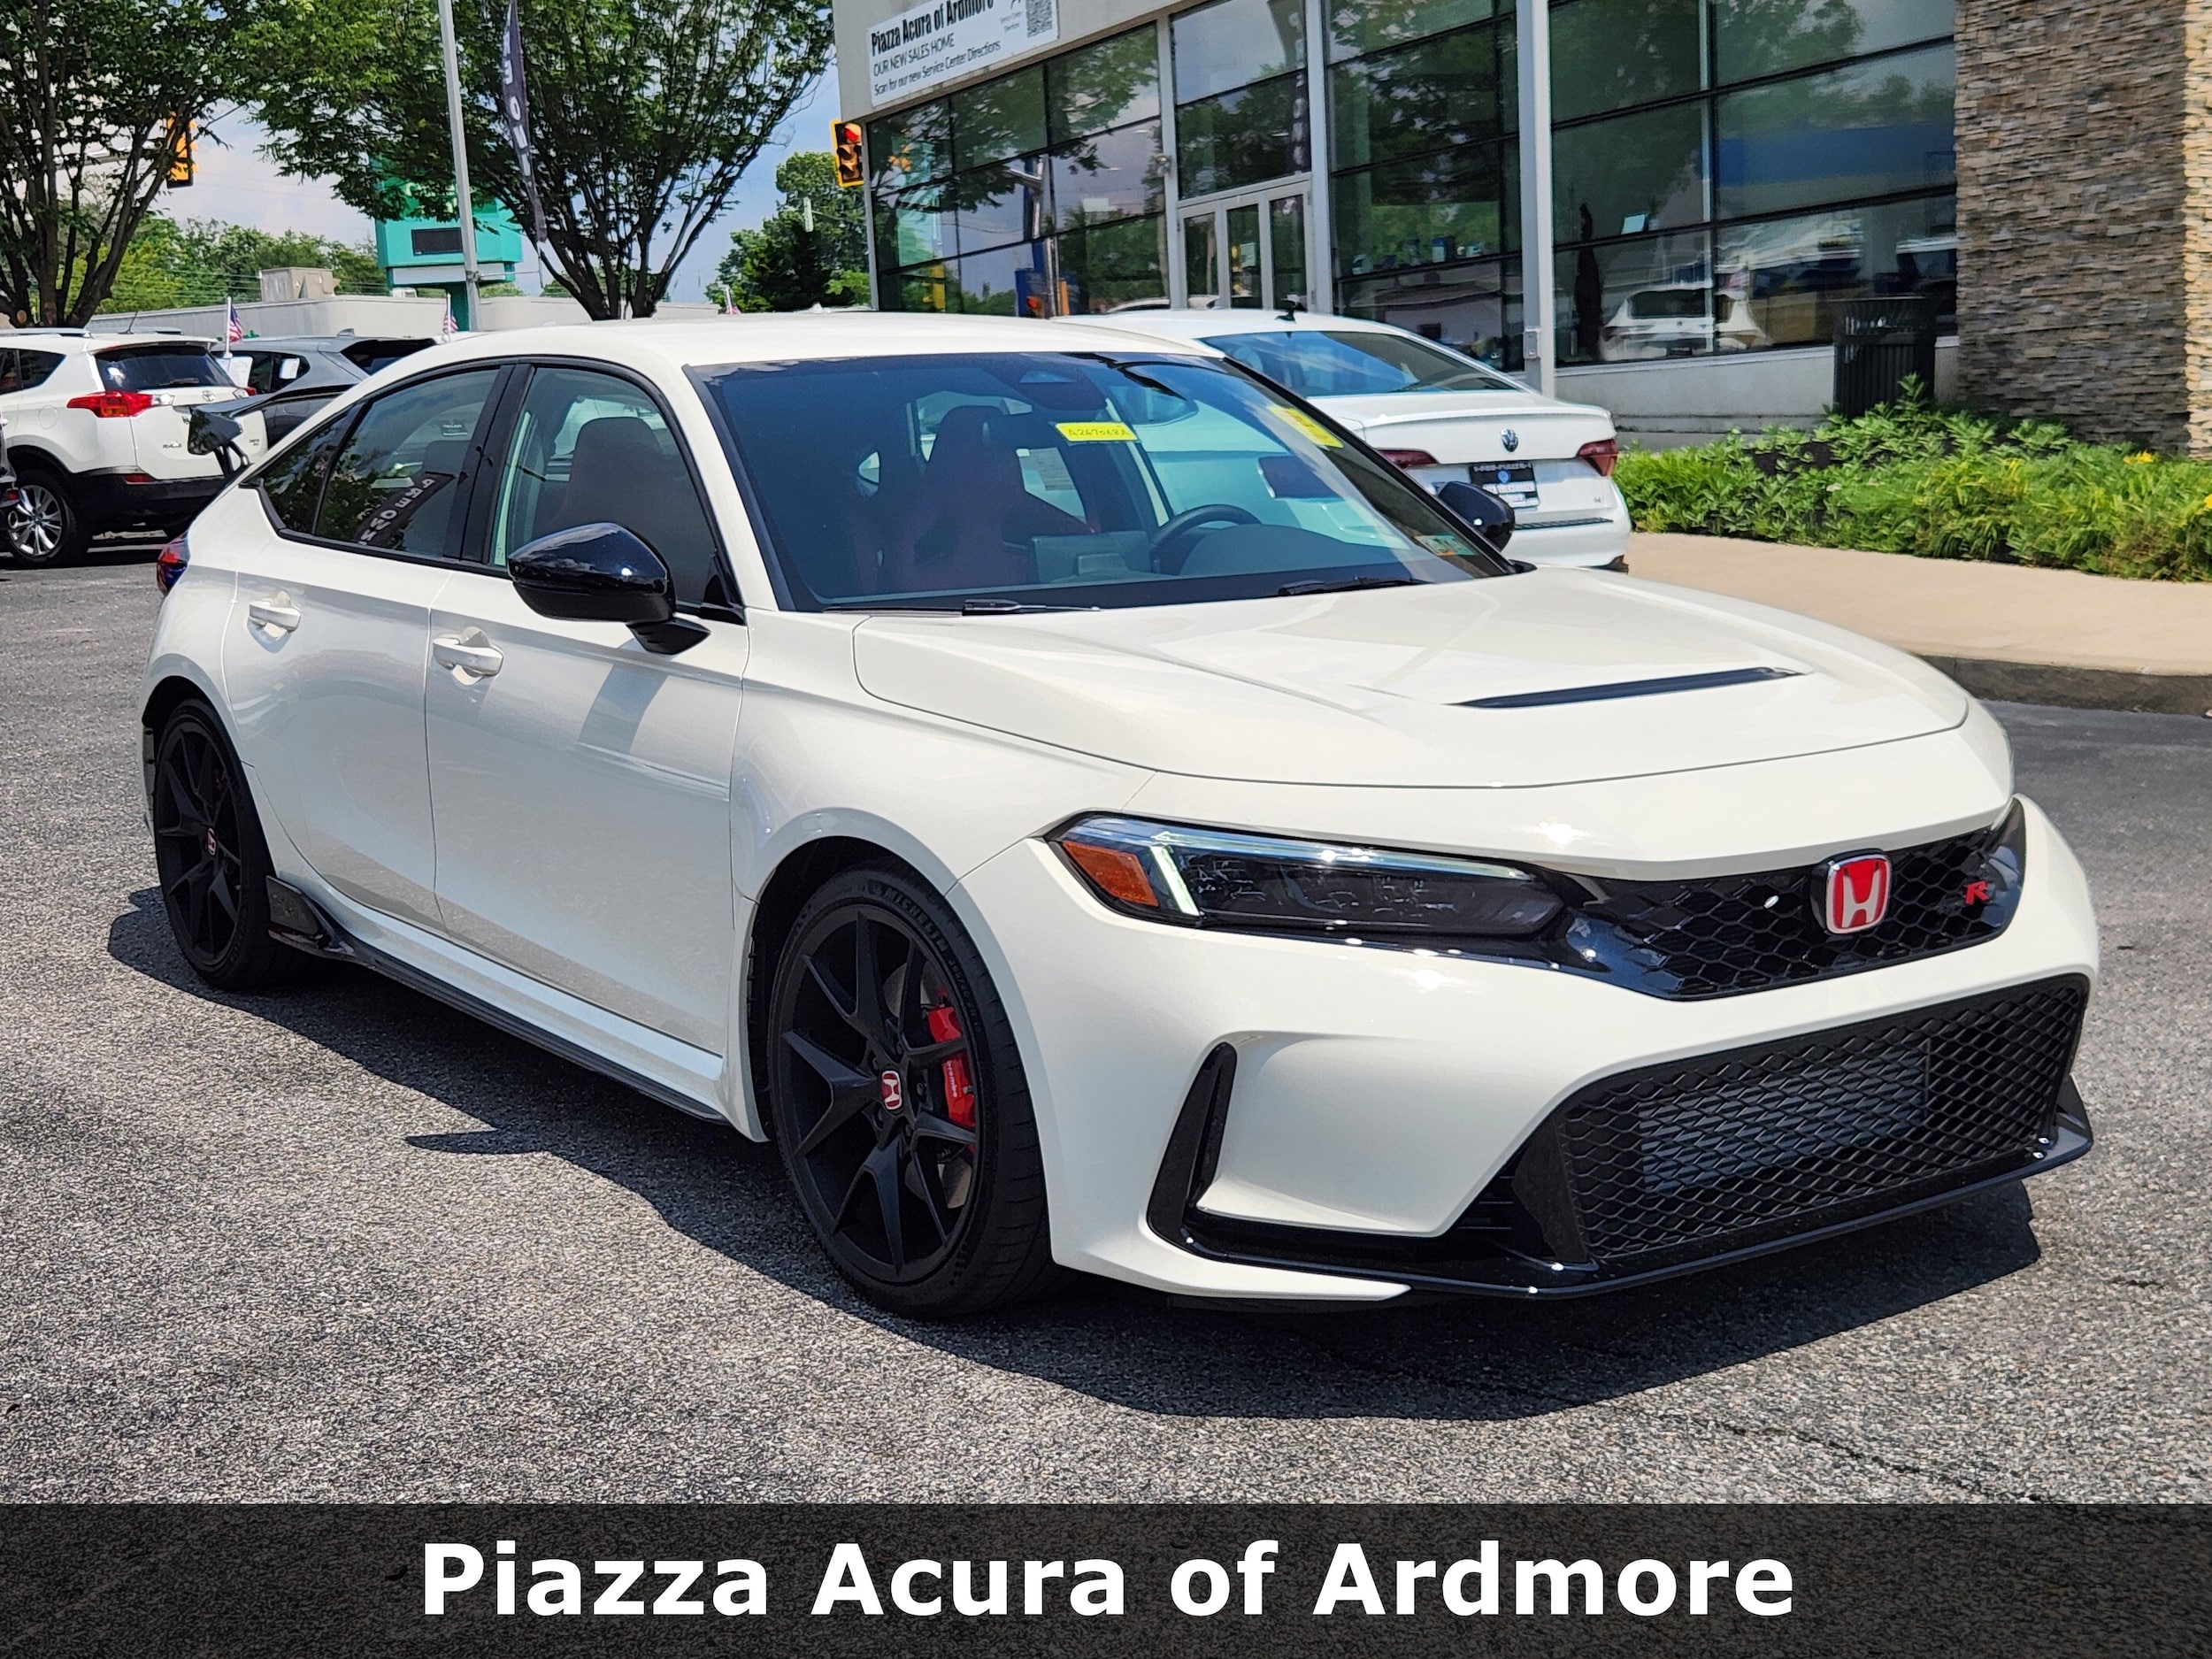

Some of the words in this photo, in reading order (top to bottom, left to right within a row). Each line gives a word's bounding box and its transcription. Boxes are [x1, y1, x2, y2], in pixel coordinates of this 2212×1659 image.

[872, 26, 902, 57] Piazza
[902, 13, 932, 44] Acura
[934, 3, 944, 32] of
[873, 60, 889, 77] OUR
[890, 50, 908, 70] NEW
[908, 42, 930, 64] SALES
[930, 32, 956, 54] HOME
[873, 81, 889, 96] Scan
[888, 77, 897, 91] for
[898, 76, 909, 87] our
[909, 71, 922, 83] new
[922, 60, 945, 79] Service
[944, 51, 966, 70] Center
[966, 41, 1002, 62] Directions
[1964, 880, 1990, 904] R
